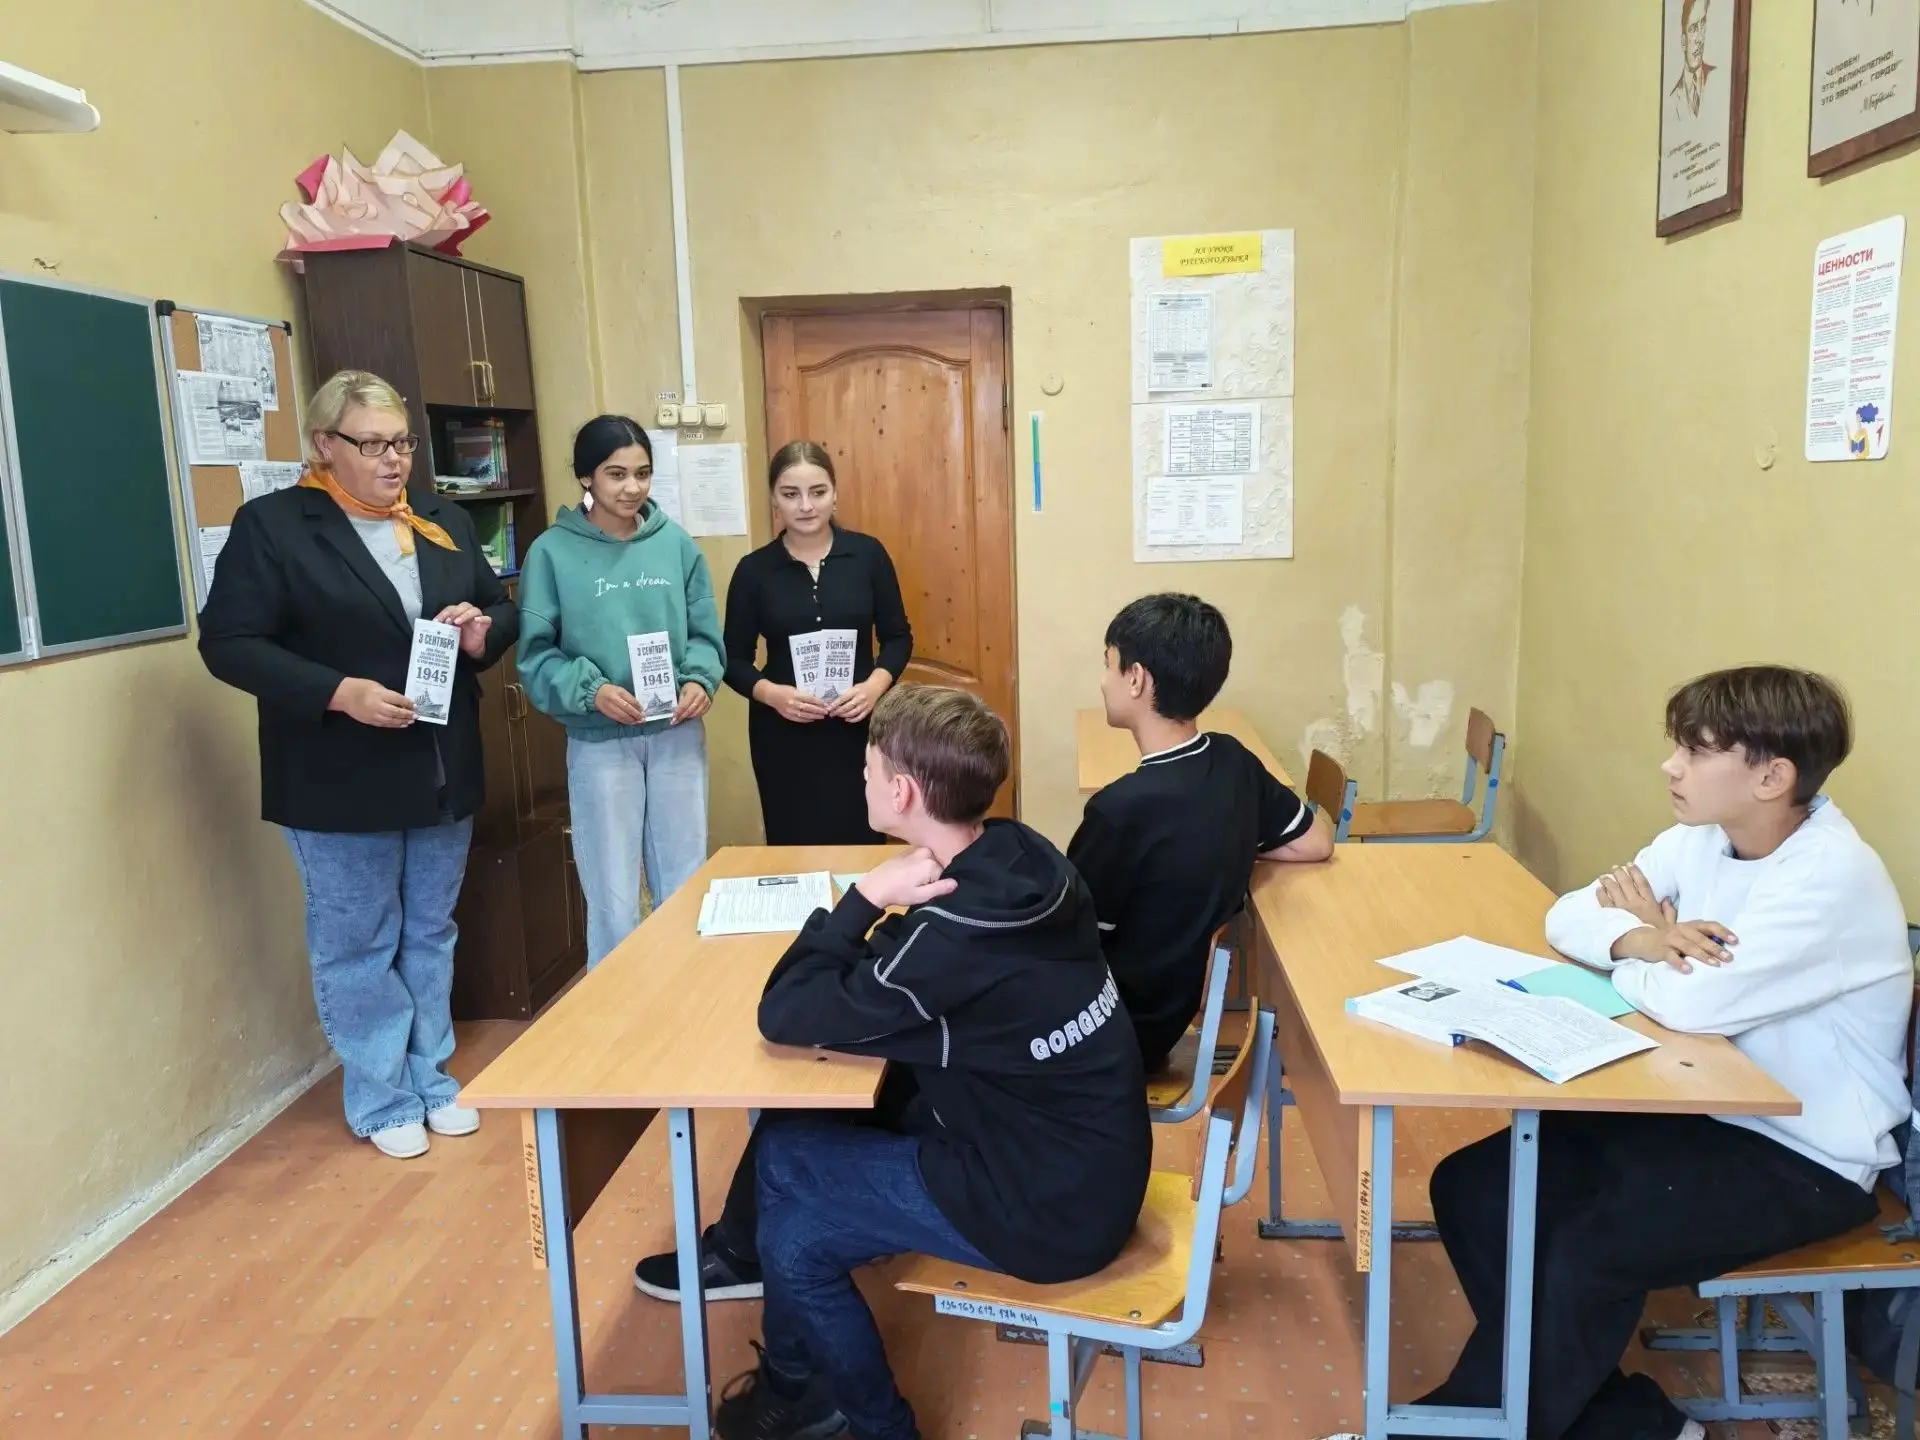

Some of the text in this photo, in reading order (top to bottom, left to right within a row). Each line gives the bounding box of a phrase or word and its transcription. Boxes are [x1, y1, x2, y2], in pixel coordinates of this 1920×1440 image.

[1818, 247, 1873, 277] ЦЕННОСТИ
[418, 633, 456, 650] 3 СЕНТЯБРЯ
[825, 640, 854, 650] 3 СЕНТЯБРЯ
[636, 643, 668, 657] 3 СЕНТЯБРЯ
[795, 646, 801, 656] 3
[415, 666, 449, 684] 1945
[642, 672, 670, 688] 1945
[824, 667, 850, 679] 1945
